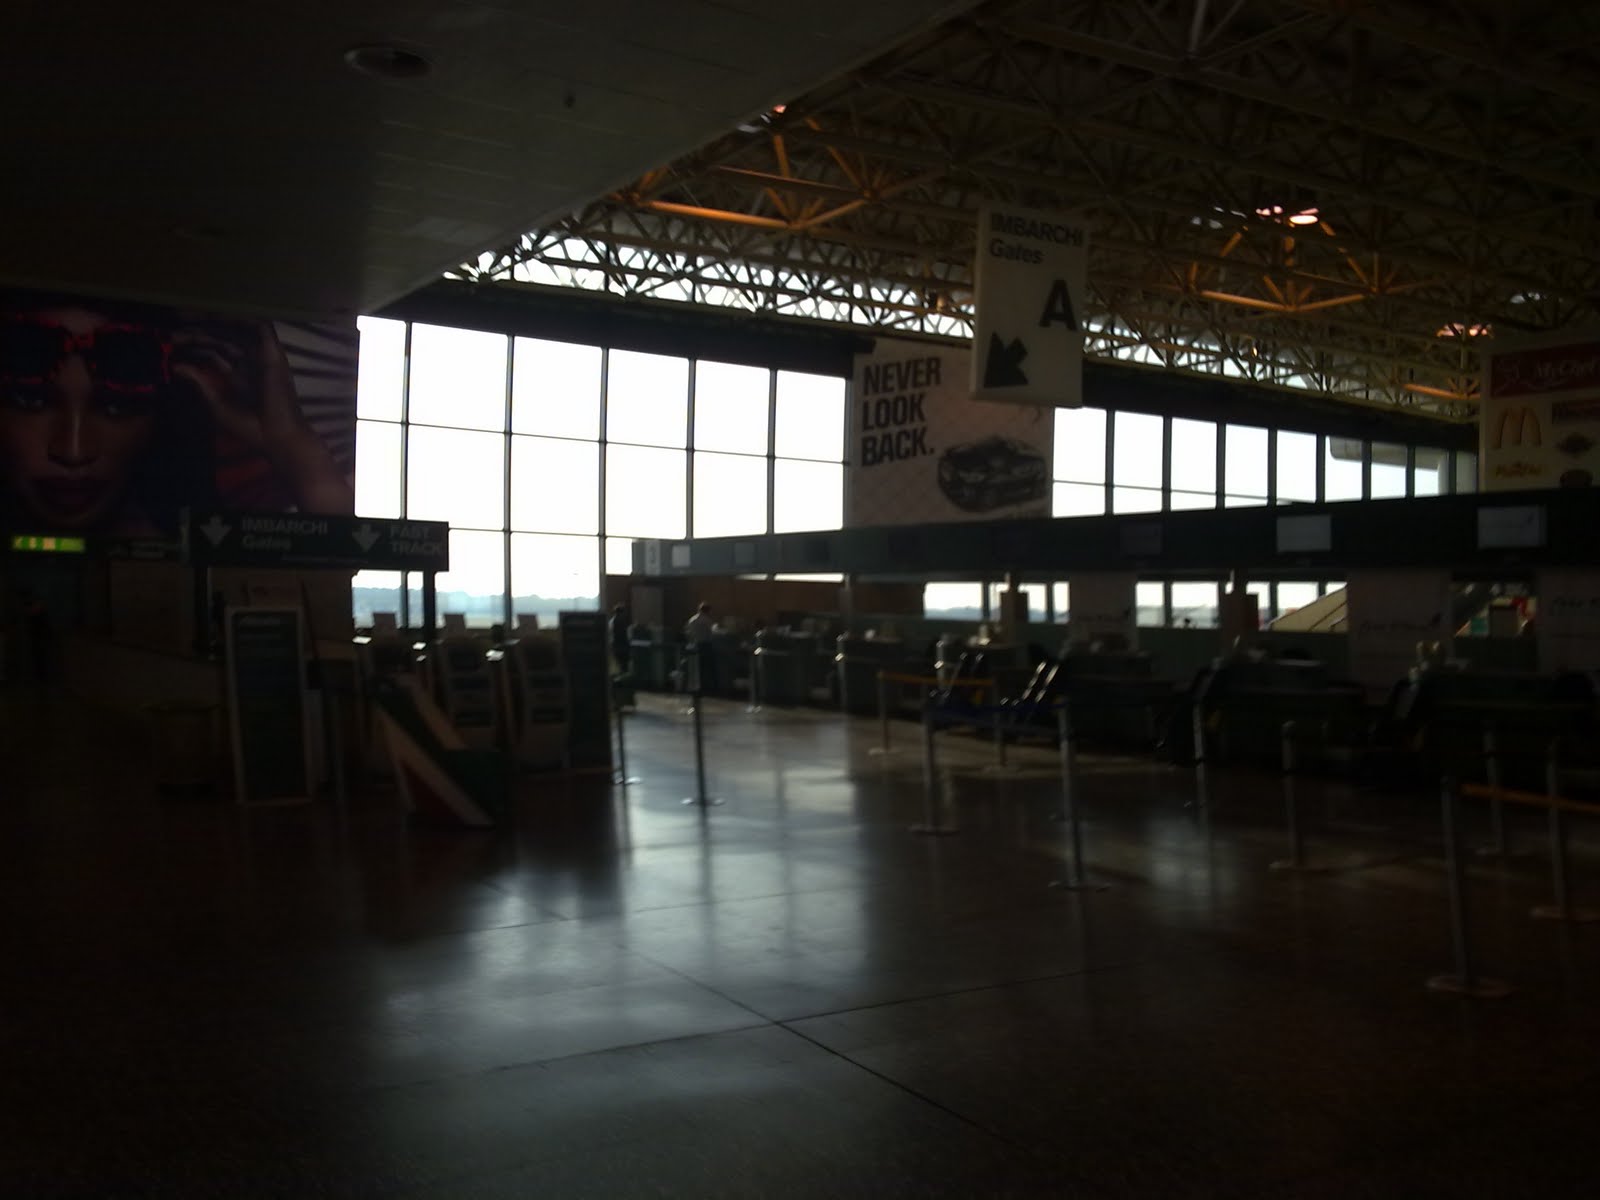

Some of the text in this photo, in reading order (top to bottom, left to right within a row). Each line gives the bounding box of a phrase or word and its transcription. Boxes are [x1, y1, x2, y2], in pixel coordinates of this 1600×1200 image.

[991, 213, 1083, 247] IMBARCHI
[990, 238, 1043, 264] Gates
[1040, 279, 1078, 331] A
[863, 357, 942, 394] NEVER
[862, 393, 926, 431] LOOK
[861, 428, 935, 466] BACK.
[242, 516, 329, 536] IMBARCHI
[389, 524, 430, 540] FAST
[241, 535, 292, 553] Gates
[390, 540, 442, 556] TRACK
